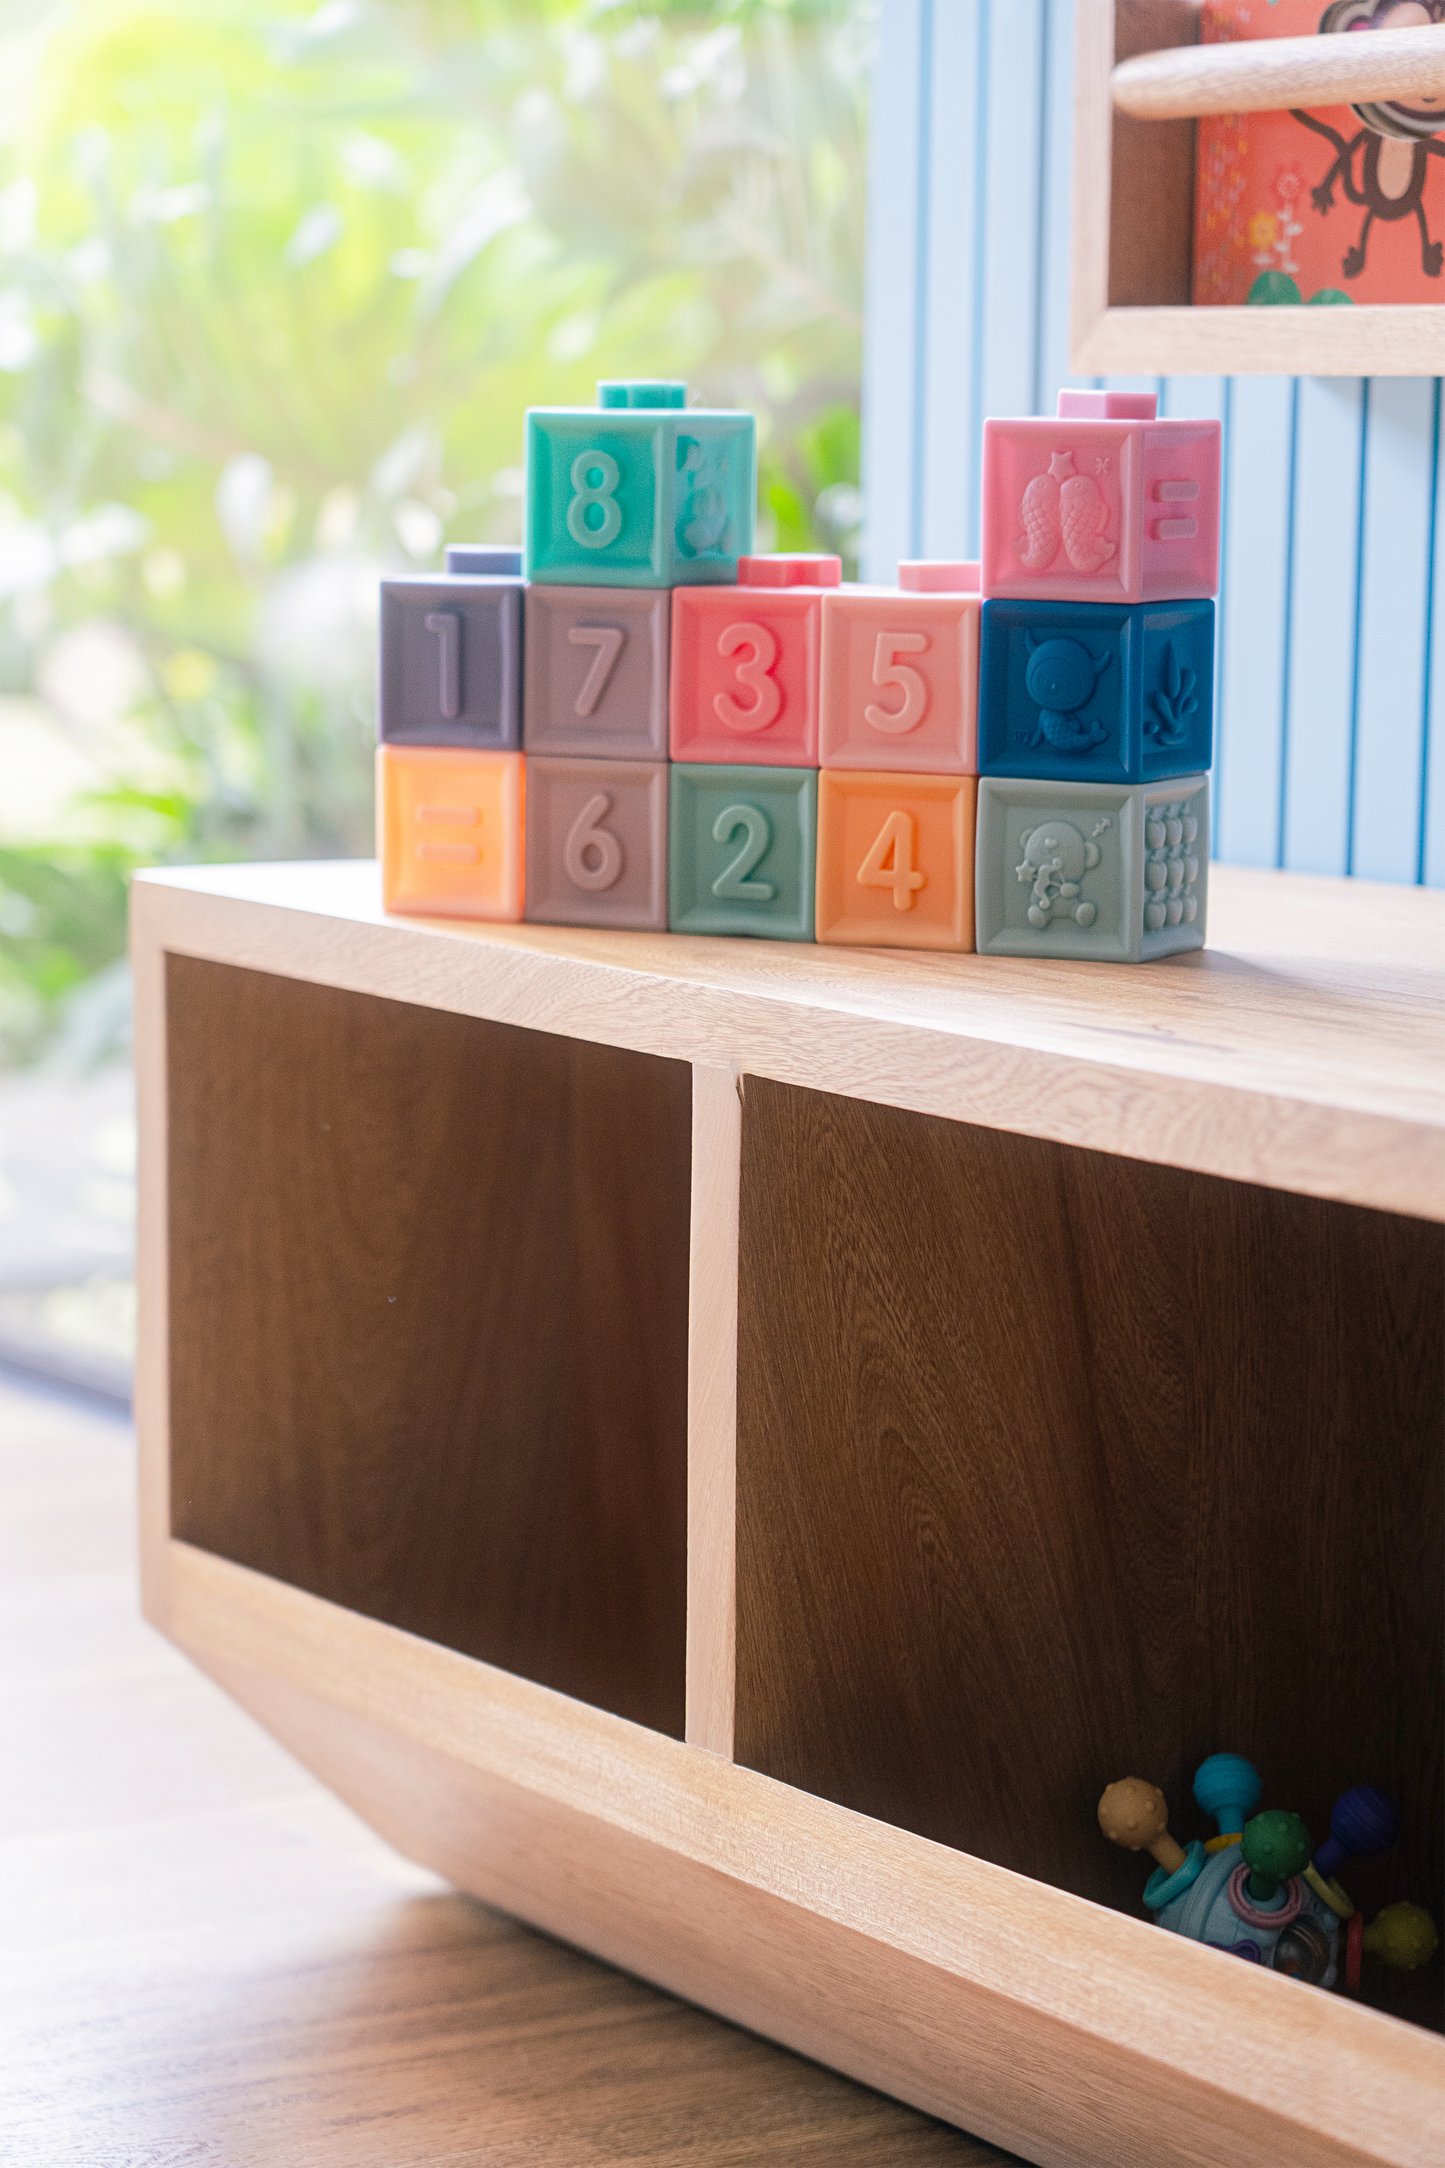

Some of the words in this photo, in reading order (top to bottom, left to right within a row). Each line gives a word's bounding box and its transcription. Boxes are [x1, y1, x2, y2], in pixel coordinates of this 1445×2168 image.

[567, 450, 622, 549] 8
[425, 613, 460, 718] 1
[567, 627, 624, 718] 7
[713, 622, 781, 731] 3
[864, 632, 928, 734] 5
[565, 794, 622, 891] 6
[711, 804, 776, 901] 2
[857, 810, 926, 912] 4
